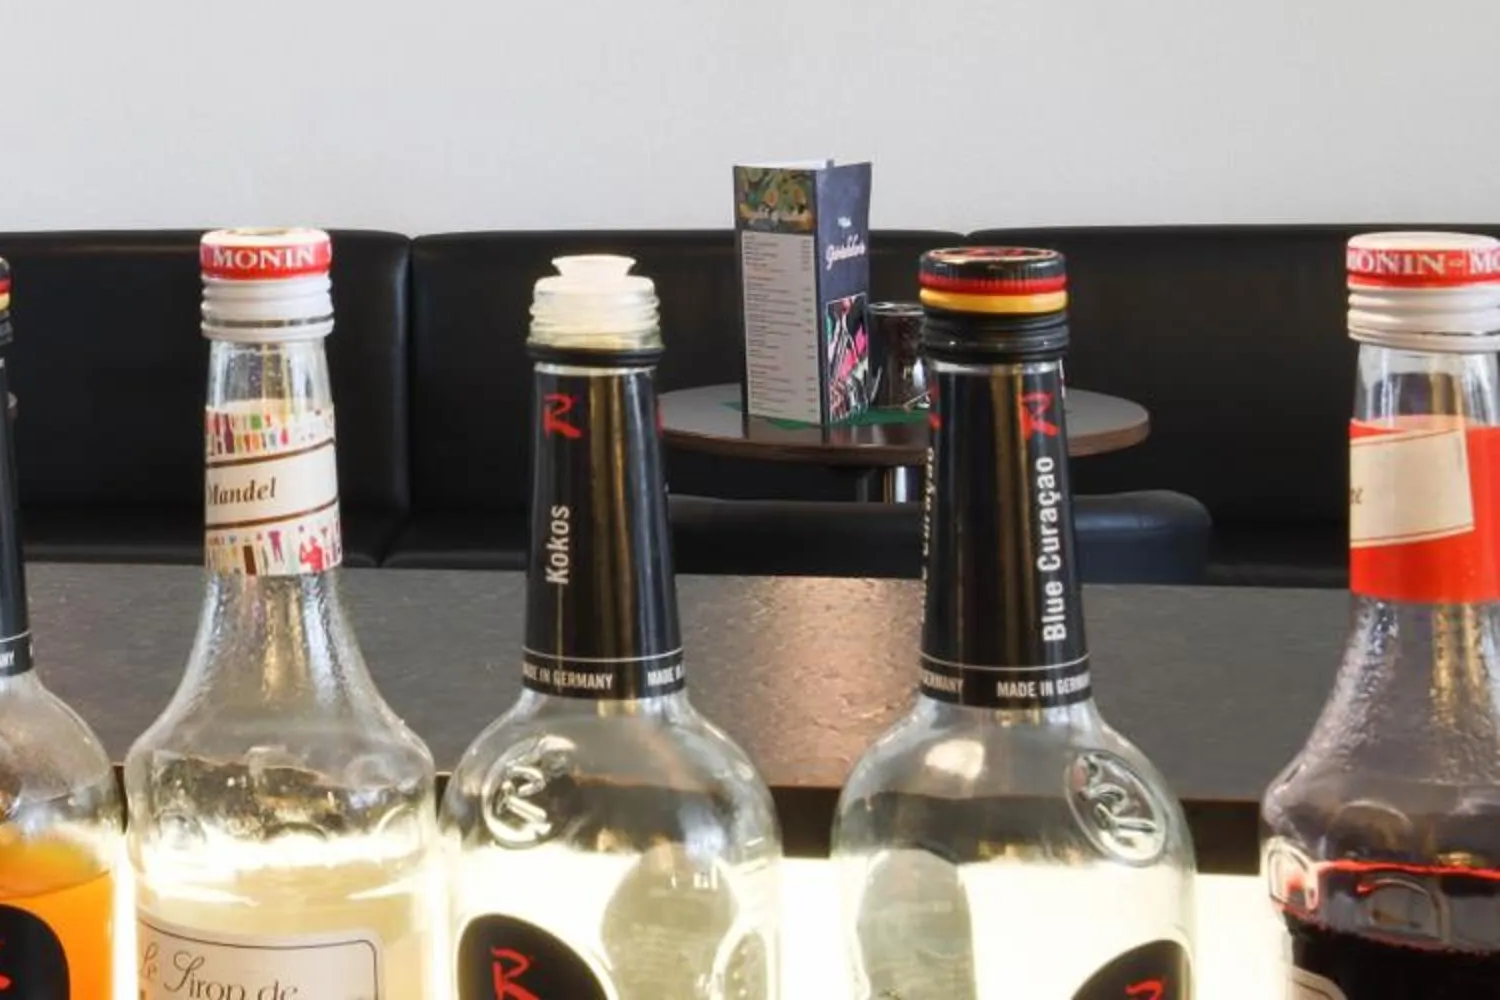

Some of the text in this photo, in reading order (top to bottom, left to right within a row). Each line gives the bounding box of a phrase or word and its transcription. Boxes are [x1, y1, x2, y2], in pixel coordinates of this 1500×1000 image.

[213, 246, 315, 270] MONIN
[545, 504, 570, 586] Kokos
[1036, 456, 1068, 642] Blue Curaçao
[553, 670, 613, 690] GERMANY
[996, 680, 1038, 698] MADE
[1040, 679, 1054, 697] IN
